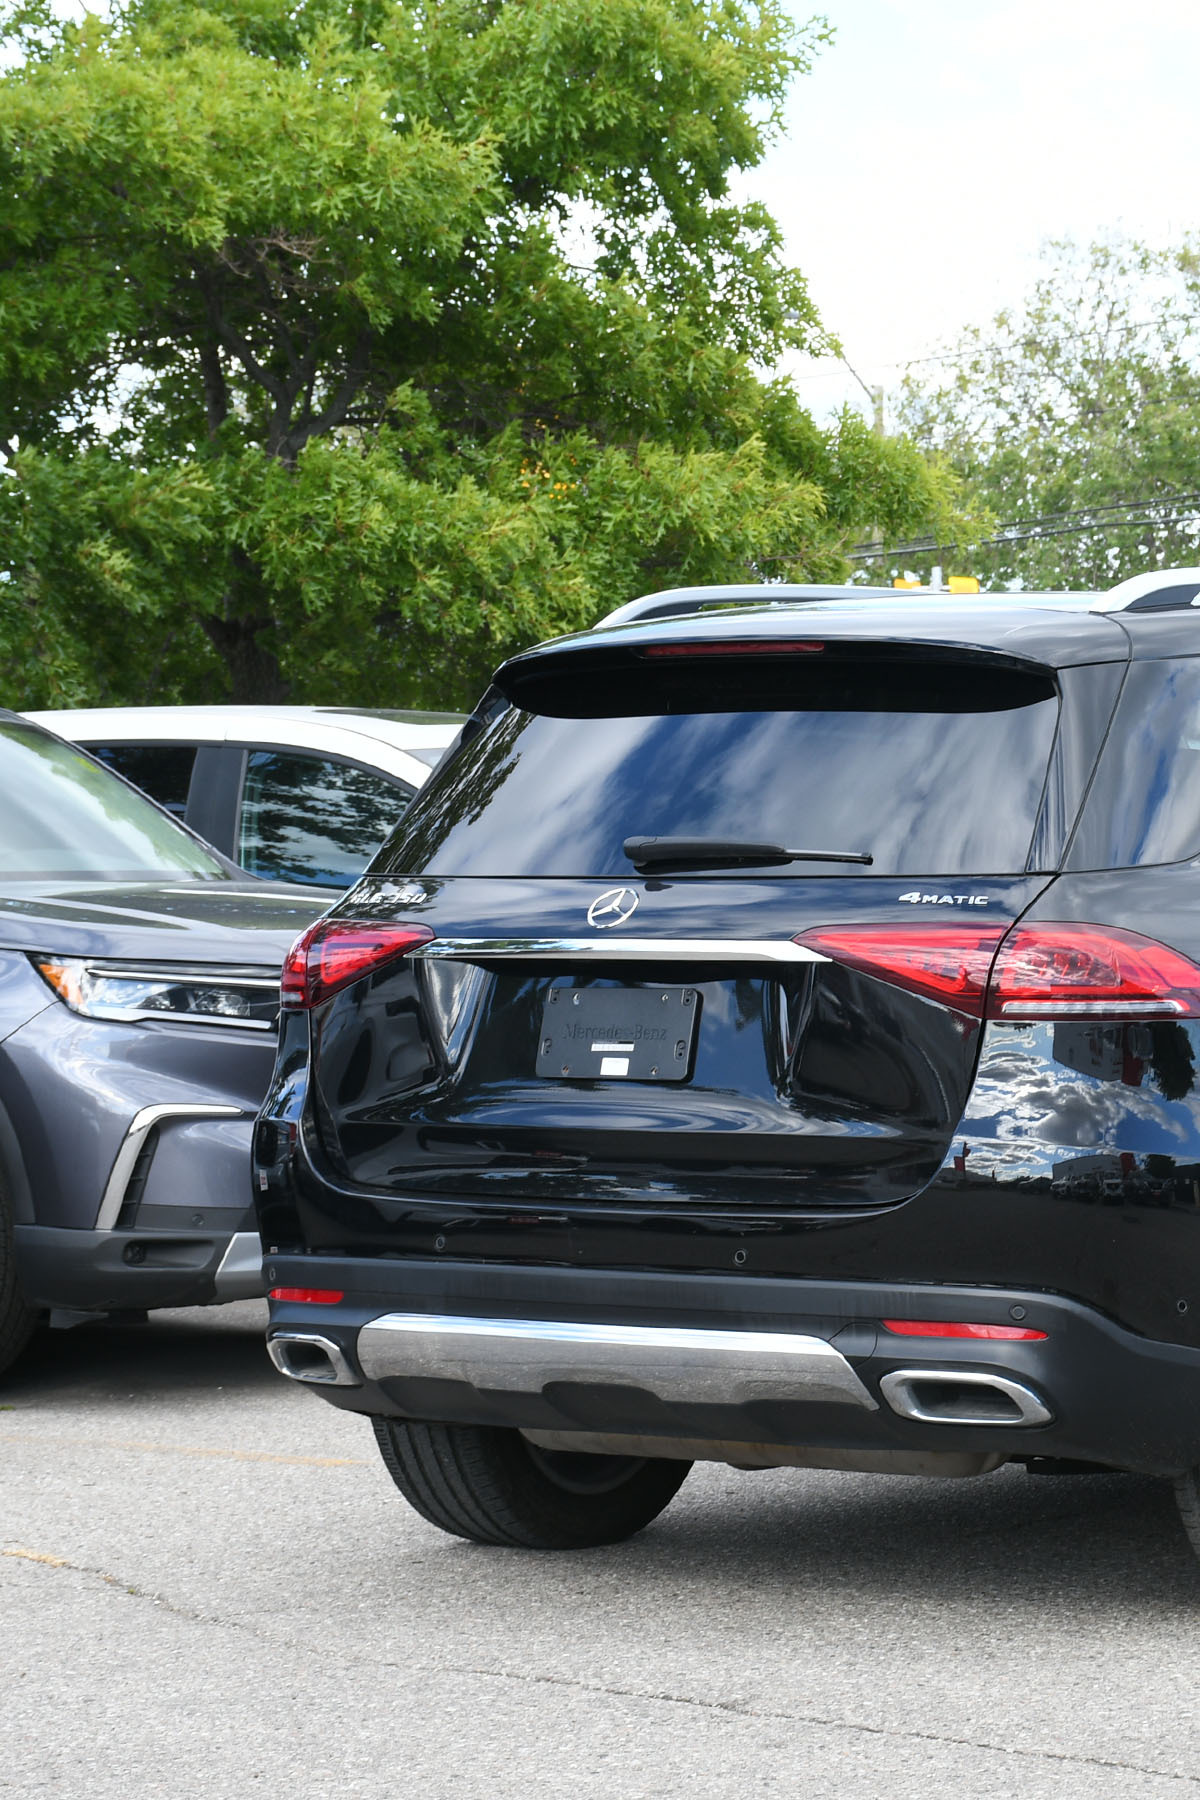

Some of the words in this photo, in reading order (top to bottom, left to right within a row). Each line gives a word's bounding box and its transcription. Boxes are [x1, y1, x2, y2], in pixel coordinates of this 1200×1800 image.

[385, 893, 428, 904] 350
[898, 891, 989, 905] 4MATIC
[562, 1023, 668, 1041] Mercedes-Benz
